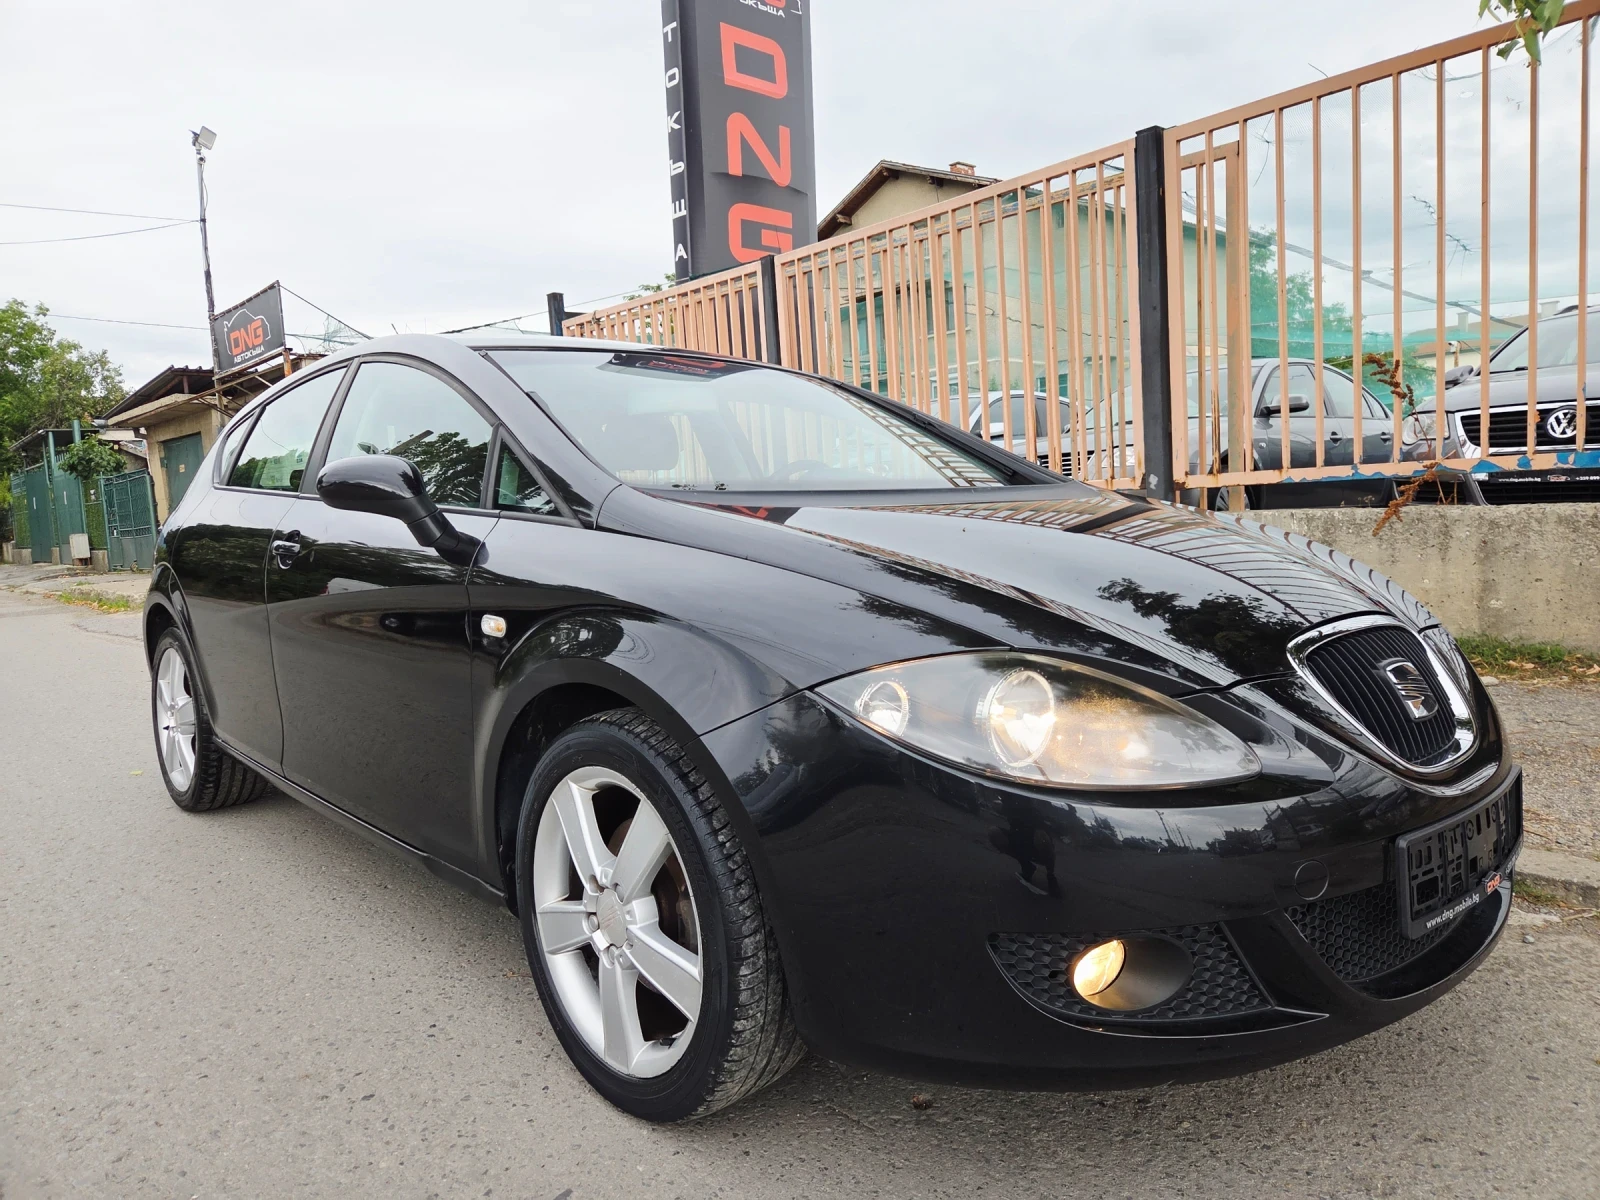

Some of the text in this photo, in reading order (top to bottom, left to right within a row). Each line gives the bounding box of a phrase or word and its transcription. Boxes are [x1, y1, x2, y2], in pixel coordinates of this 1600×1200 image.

[719, 21, 793, 264] DNG
[230, 319, 263, 355] DNG
[1426, 893, 1480, 929] www.dng.mobile.bg
